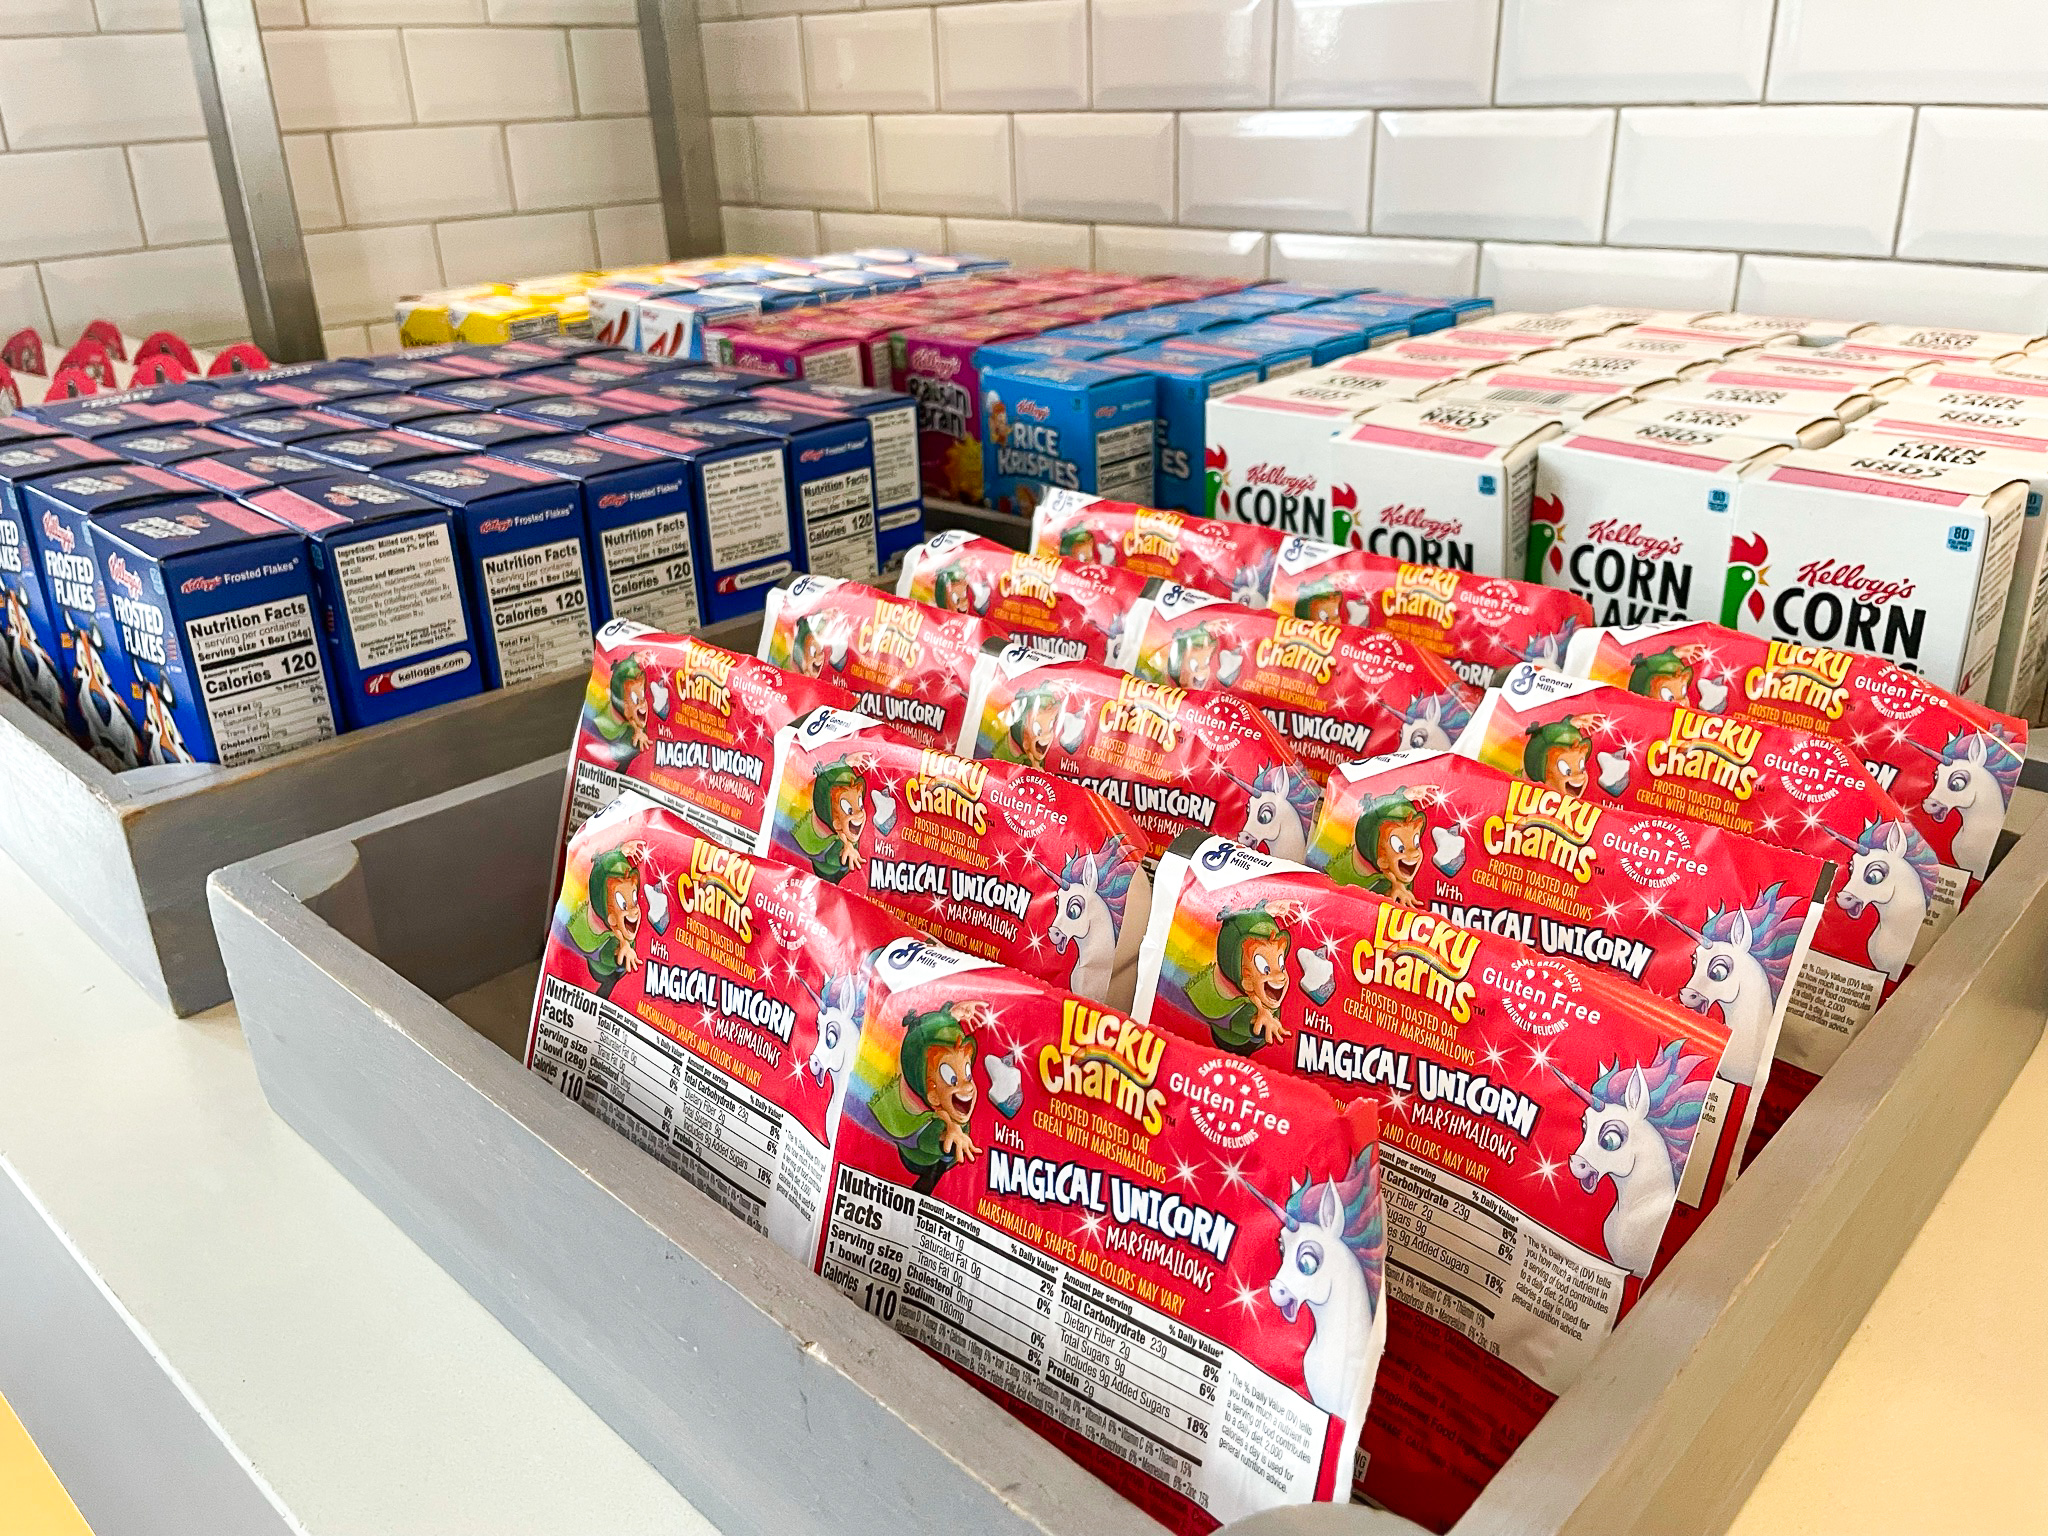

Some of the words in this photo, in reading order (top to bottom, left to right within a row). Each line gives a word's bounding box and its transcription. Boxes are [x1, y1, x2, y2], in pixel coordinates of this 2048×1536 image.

[1013, 422, 1059, 457] RICE
[1889, 448, 1977, 465] FLAKES
[1898, 441, 1986, 458] CORN
[998, 449, 1079, 491] KRISPIES
[1247, 462, 1317, 496] Kellogg's
[1235, 487, 1325, 536] CORN
[1381, 503, 1463, 540] Kellogg's
[604, 527, 655, 547] Nutrition
[657, 519, 685, 536] Facts
[1368, 527, 1473, 573] CORN
[1589, 518, 1684, 560] Kellogg's
[45, 550, 94, 585] FROSTED
[224, 568, 261, 585] Frosted
[486, 554, 542, 574] Nutrition
[546, 544, 578, 561] Facts
[1569, 544, 1693, 610] CORN
[55, 580, 96, 613] FLAKES
[612, 576, 659, 596] Calories
[666, 562, 690, 580] 120
[1799, 559, 1915, 604] Kellogg's
[113, 593, 163, 635] FROSTED
[190, 612, 261, 638] Nutrition
[264, 602, 306, 621] Facts
[496, 605, 548, 626] Calories
[556, 590, 584, 610] 120
[1773, 587, 1926, 659] CORN
[122, 626, 165, 665] FLAKES
[1341, 645, 1381, 664] Gluten
[1384, 655, 1414, 674] Free
[206, 668, 272, 694] Calories
[281, 651, 317, 675] 120
[398, 656, 464, 682] kelloggs.com
[1539, 675, 1573, 689] General
[1536, 683, 1555, 693] Mills
[1745, 667, 1849, 720] Charms
[1855, 675, 1906, 698] Gluten
[1911, 689, 1948, 708] Free
[1186, 709, 1226, 729] Gluten
[1229, 721, 1262, 740] Free
[1292, 715, 1371, 752] UNICORN
[578, 762, 617, 787] Nutrition
[656, 741, 709, 768] MAGICAL
[712, 748, 763, 786] UNICORN
[1648, 742, 1758, 801] Charms
[1763, 753, 1820, 778] Gluten
[1823, 768, 1865, 791] Free
[576, 780, 599, 798] Facts
[905, 778, 988, 836] Charms
[990, 790, 1032, 815] Gluten
[1035, 805, 1068, 825] Free
[1134, 786, 1216, 827] UNICORN
[1230, 857, 1250, 870] Mills
[1236, 851, 1272, 868] General
[1483, 815, 1598, 884] Charms
[1602, 833, 1661, 865] Gluten
[1665, 852, 1708, 877] Free
[678, 873, 752, 944] Charms
[870, 860, 948, 895] MAGICAL
[952, 873, 1031, 920] UNICORN
[1436, 880, 1463, 901] With
[755, 894, 794, 926] Gluten
[796, 916, 828, 940] Free
[948, 905, 1017, 943] MARSHMALLOWS
[916, 955, 937, 968] Mills
[924, 948, 958, 965] General
[1542, 922, 1652, 978] UNICORN
[546, 981, 598, 1017] Nutrition
[1352, 938, 1476, 1024] Charms
[1482, 967, 1546, 1005] Gluten
[1552, 994, 1600, 1025] Free
[543, 1004, 574, 1028] Facts
[646, 961, 717, 1008] MAGICAL
[721, 980, 796, 1043] UNICORN
[1305, 1009, 1333, 1034] With
[715, 1018, 782, 1068] MARSHMALLOWS
[561, 1071, 583, 1101] 110
[1039, 1045, 1167, 1135] Charms
[1198, 1059, 1223, 1076] SAME
[1225, 1059, 1252, 1076] GREAT
[1252, 1070, 1269, 1099] TASTE
[1298, 1035, 1412, 1090] MAGICAL
[1418, 1059, 1540, 1138] UNICORN
[1169, 1073, 1235, 1114] Gluten
[1240, 1100, 1290, 1134] Free
[995, 1122, 1024, 1150] With
[1050, 1098, 1090, 1124] FROSTED
[1091, 1114, 1129, 1146] TOASTED
[1132, 1133, 1150, 1154] OAT
[1190, 1106, 1221, 1144] MAGICALLY
[1223, 1129, 1258, 1148] DELICIOUS
[1412, 1103, 1517, 1164] MARSHMALLOWS
[1034, 1111, 1063, 1135] CEREAL
[1066, 1124, 1089, 1148] WITH
[1091, 1137, 1166, 1183] MARSHMALLOWS
[840, 1168, 915, 1216] Nutrition
[989, 1150, 1106, 1212] MAGICAL
[1110, 1177, 1237, 1262] UNICORN
[836, 1196, 882, 1230] Facts
[832, 1225, 875, 1254] Serving
[877, 1244, 904, 1262] size
[916, 1216, 934, 1234] Total
[937, 1226, 950, 1242] Fat
[955, 1235, 964, 1250] 1g
[830, 1241, 835, 1254] 1
[838, 1244, 865, 1266] bowl
[869, 1258, 901, 1283] (28g)
[918, 1252, 936, 1270] Trans
[938, 1263, 949, 1277] Fat
[953, 1270, 963, 1286] 0g
[920, 1235, 954, 1262] Saturated
[955, 1256, 967, 1269] Fat
[971, 1264, 980, 1278] 0g
[978, 1198, 1043, 1242] MARSHMALLOW
[1044, 1231, 1077, 1261] SHAPES
[1078, 1251, 1098, 1271] AND
[1100, 1260, 1134, 1291] COLORS
[1138, 1278, 1158, 1302] MAY
[1161, 1289, 1185, 1315] VARY
[1106, 1226, 1215, 1293] MARSHMALLOWS
[823, 1263, 859, 1292] Calories
[907, 1266, 952, 1297] Cholesterol
[957, 1292, 972, 1310] 0mg
[1040, 1281, 1054, 1297] 2%
[865, 1283, 898, 1320] 110
[903, 1282, 935, 1305] Sodium
[940, 1300, 964, 1323] 180mg
[1037, 1298, 1050, 1314] 0%
[1031, 1332, 1044, 1348] 0%
[1061, 1291, 1082, 1314] Total
[1083, 1304, 1145, 1344] Carbohydrate
[1151, 1338, 1167, 1357] 23g
[1064, 1312, 1092, 1337] Dietary
[1094, 1326, 1115, 1349] Fiber
[1118, 1341, 1130, 1358] 2g
[1028, 1350, 1041, 1366] 8%
[1061, 1330, 1079, 1351] Total
[1082, 1340, 1109, 1366] Sugars
[1115, 1358, 1125, 1375] 9g
[1048, 1360, 1079, 1388] Protein
[1083, 1380, 1094, 1397] 2g
[1064, 1350, 1098, 1379] Includes
[1099, 1369, 1110, 1387] 9g
[1112, 1374, 1137, 1400] Added
[1140, 1390, 1170, 1418] Sugars
[1199, 1383, 1216, 1401] 6%
[1203, 1365, 1219, 1382] 8%
[1187, 1417, 1208, 1437] 18%
